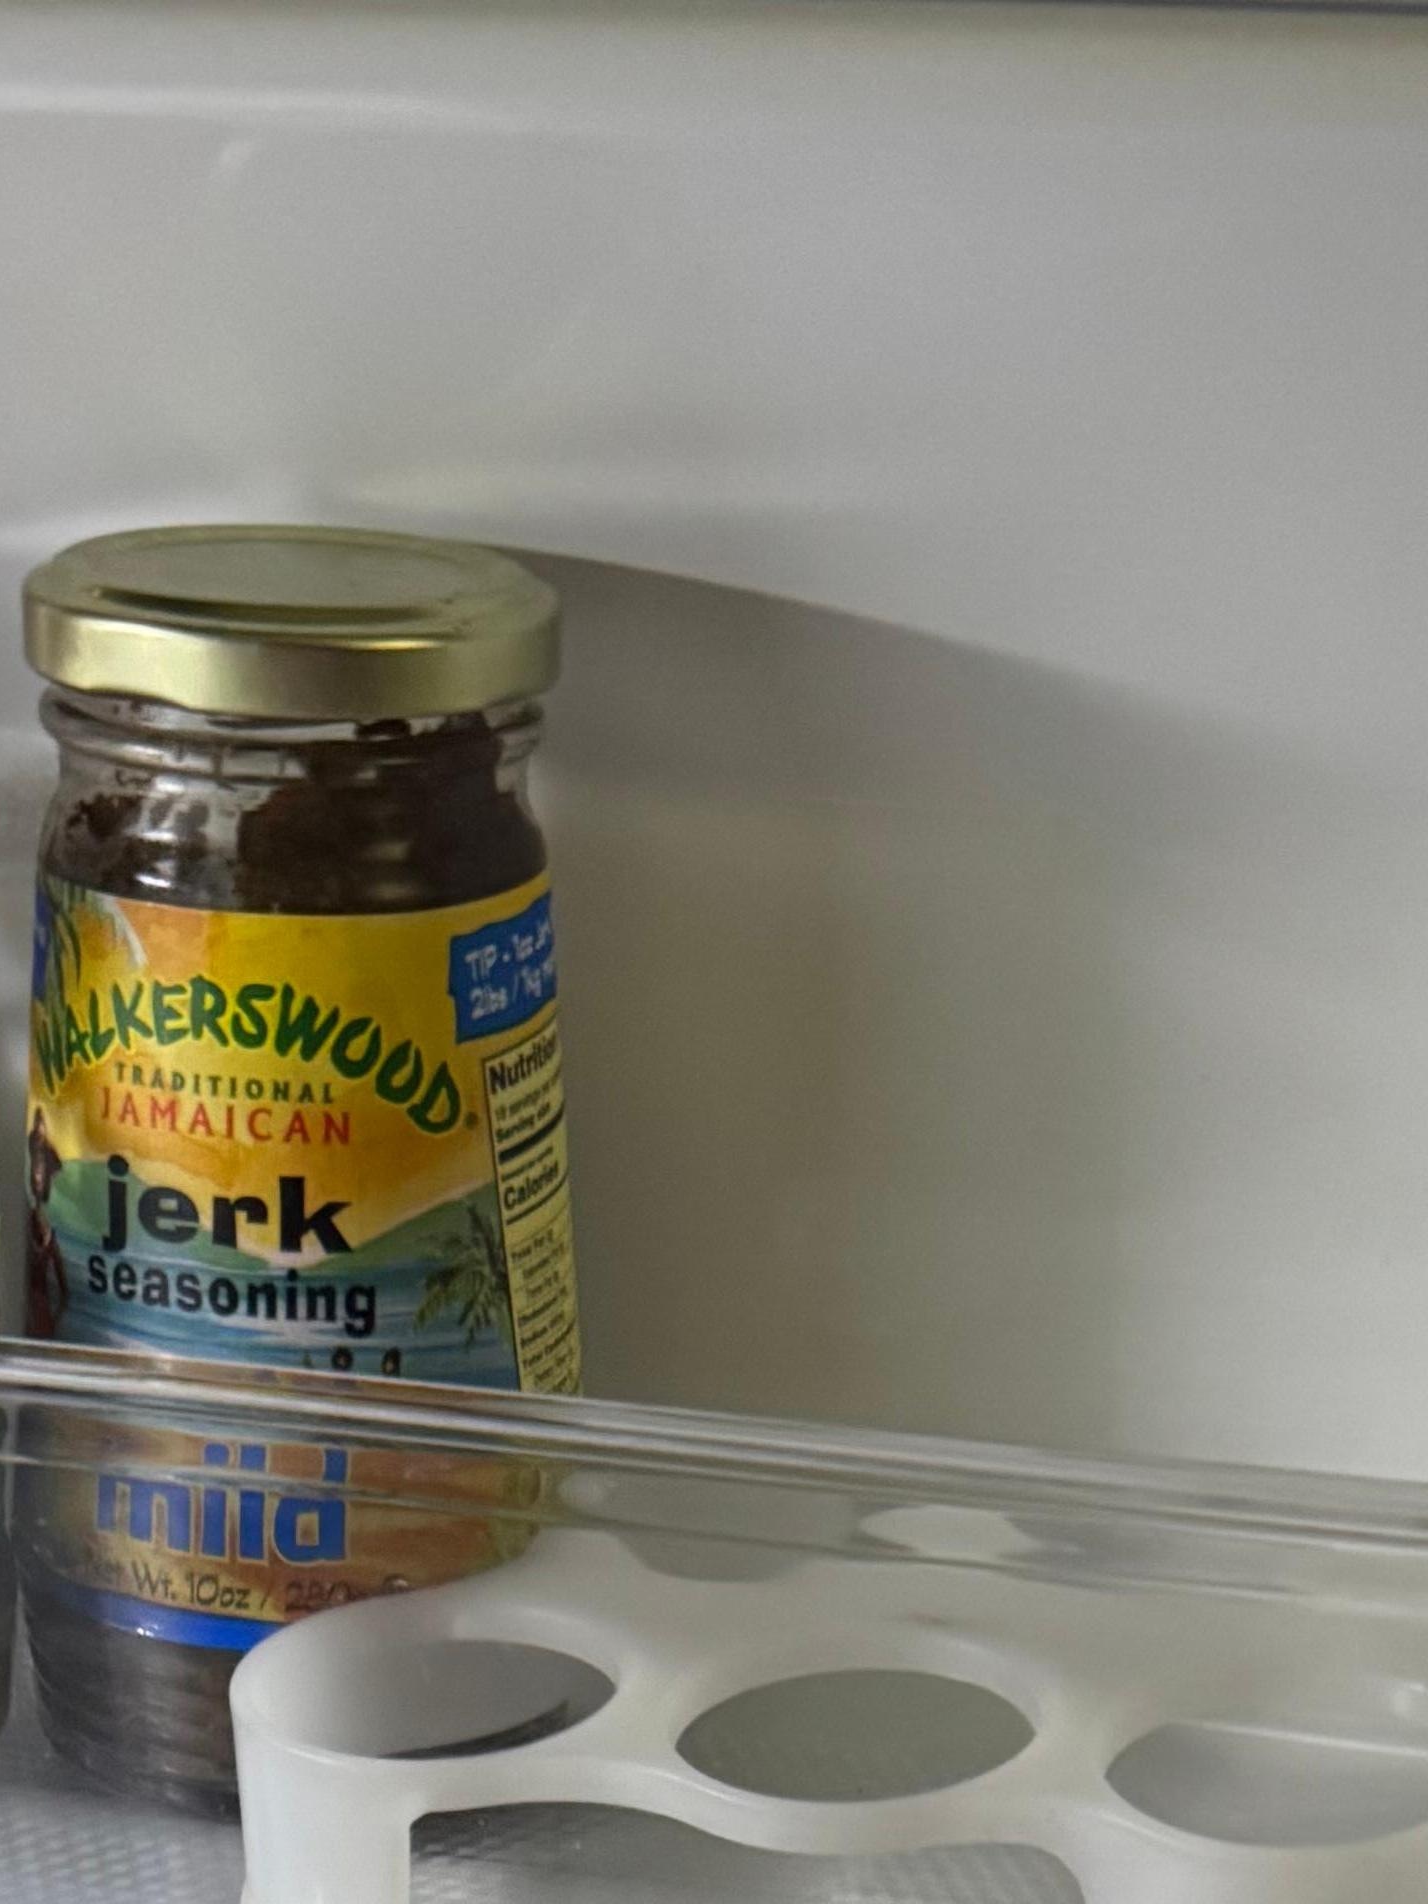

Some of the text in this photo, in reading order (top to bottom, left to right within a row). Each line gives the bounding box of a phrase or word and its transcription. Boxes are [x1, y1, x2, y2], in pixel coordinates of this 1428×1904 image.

[101, 1087, 354, 1147] JAMAICAN
[112, 1060, 337, 1107] TRADITIONAL
[100, 1154, 355, 1255] jerk
[88, 1255, 378, 1339] seasoning
[95, 1443, 351, 1564] mild
[184, 1570, 251, 1610] 10oz
